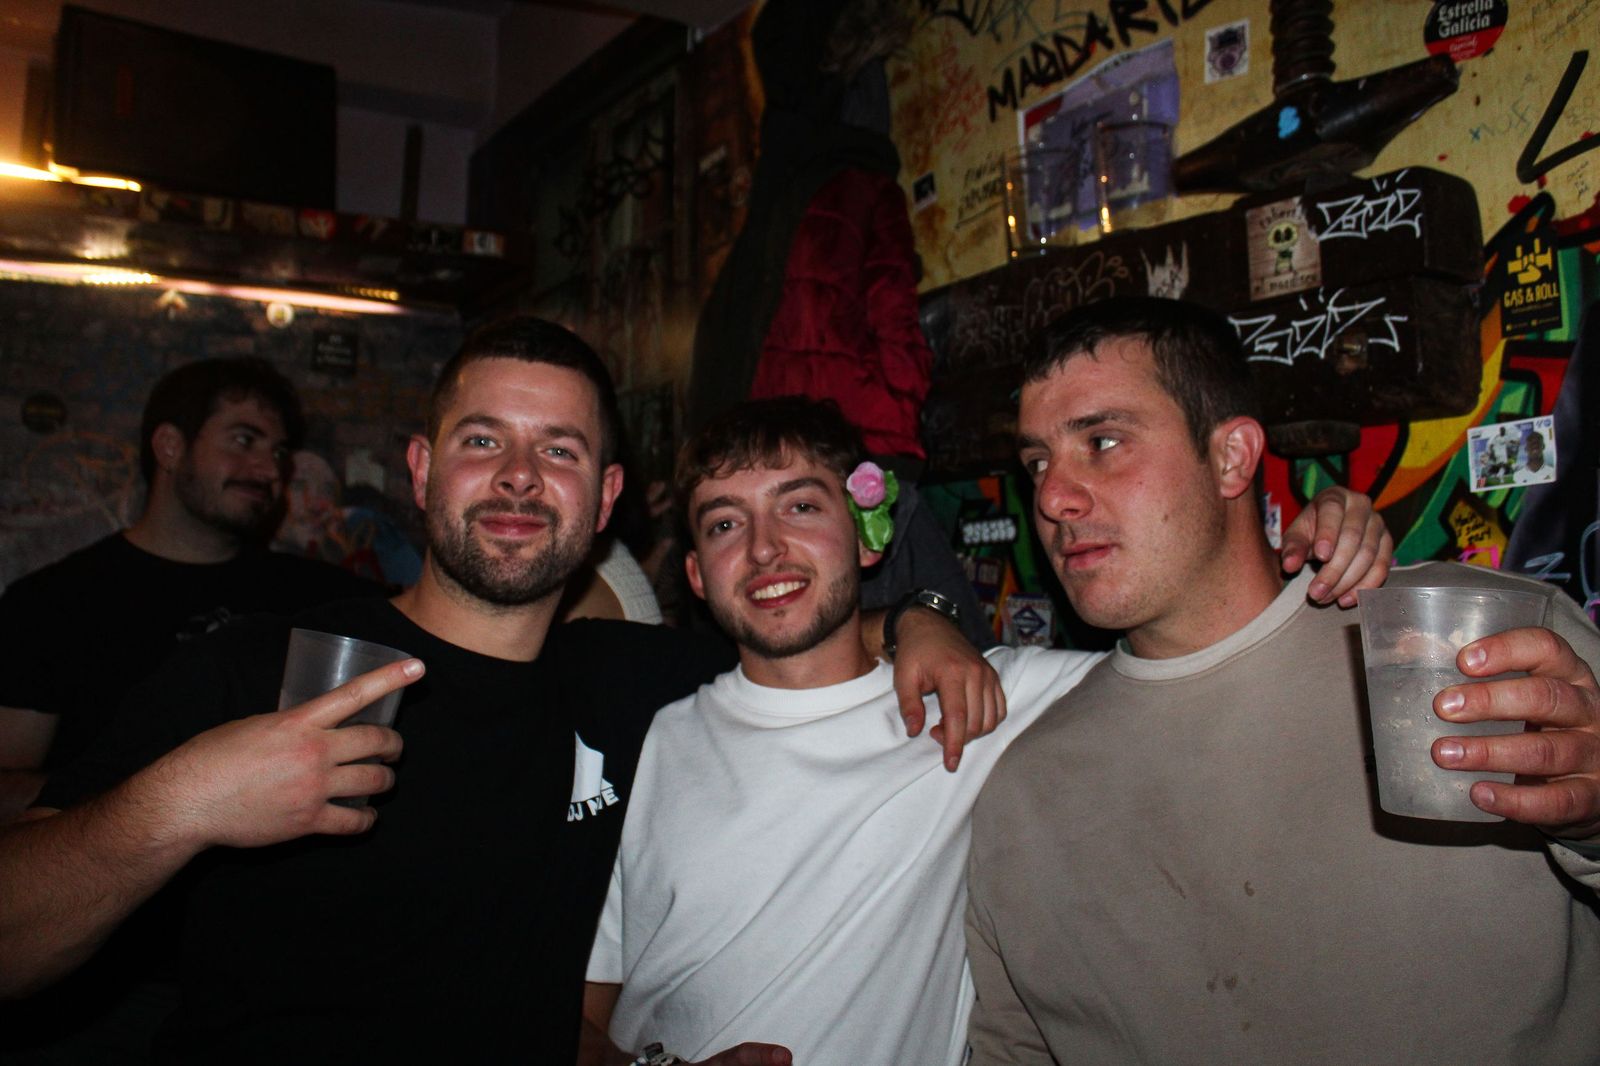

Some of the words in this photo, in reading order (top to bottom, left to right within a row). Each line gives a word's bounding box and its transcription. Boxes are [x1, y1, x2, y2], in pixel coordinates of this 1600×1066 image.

[1437, 0, 1494, 21] Estrella
[1438, 13, 1491, 38] Galicia
[1503, 288, 1524, 309] GAS
[1525, 286, 1535, 304] &
[1535, 282, 1560, 303] ROLL
